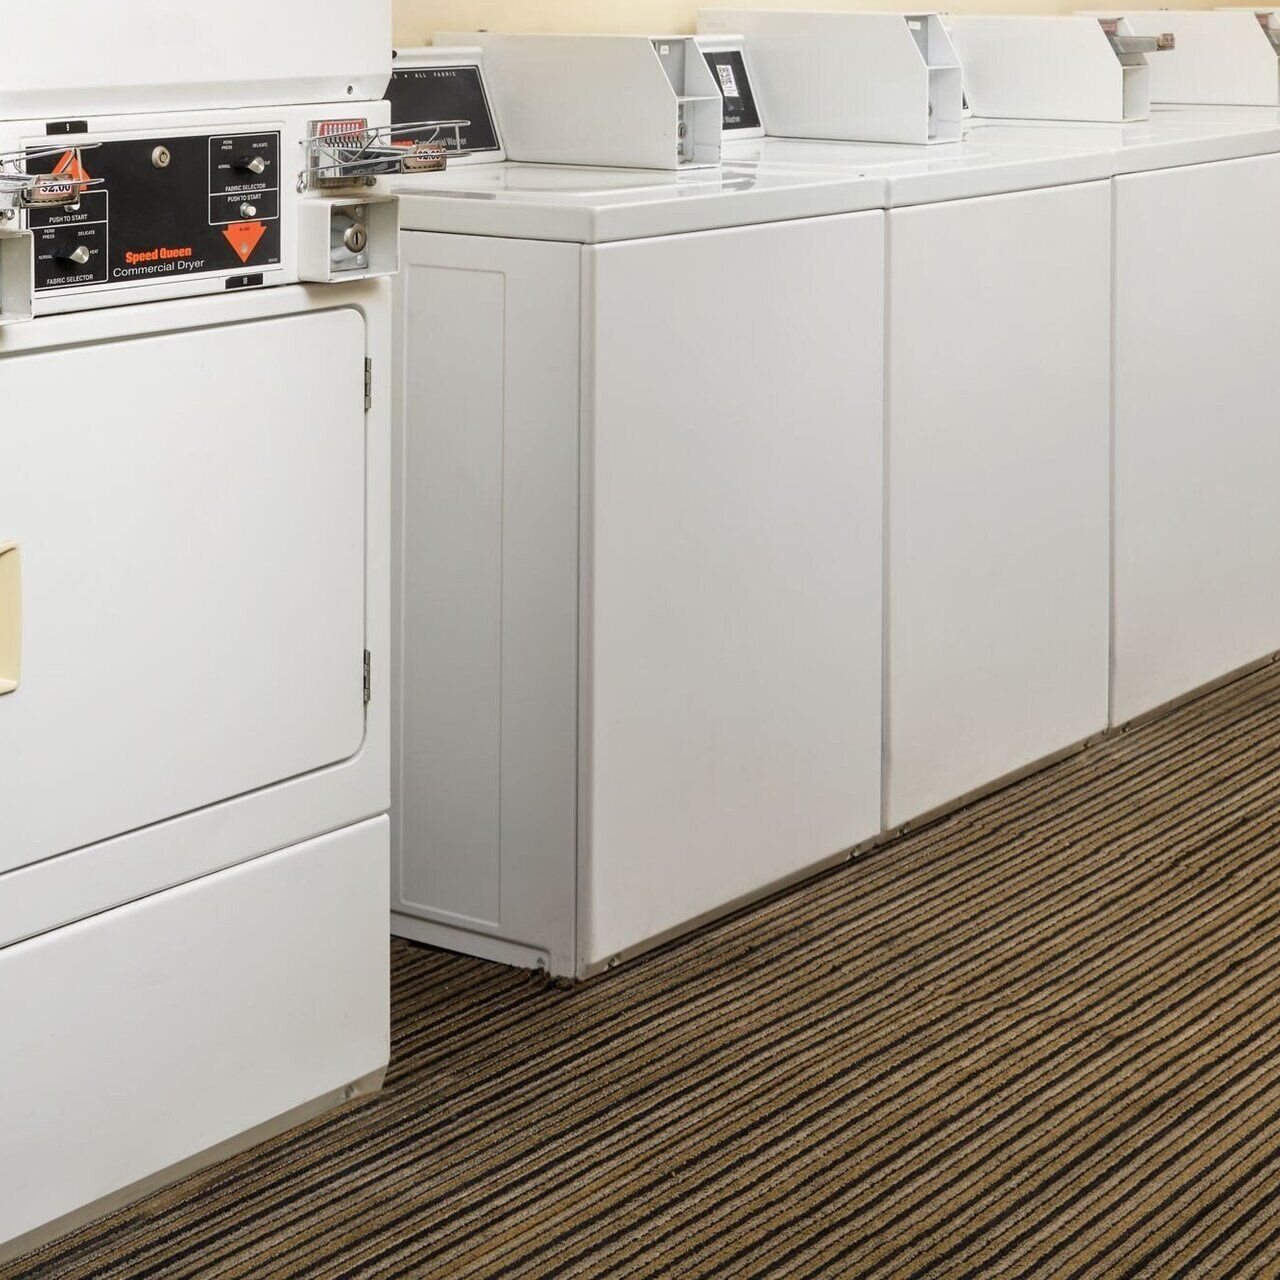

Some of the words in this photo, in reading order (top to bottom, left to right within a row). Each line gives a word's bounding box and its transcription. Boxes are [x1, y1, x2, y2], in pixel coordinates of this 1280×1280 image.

[125, 249, 158, 265] Speed
[159, 247, 192, 259] Queen
[113, 262, 175, 277] Commercial
[177, 260, 205, 270] Dryer
[66, 274, 94, 283] SELECTOR
